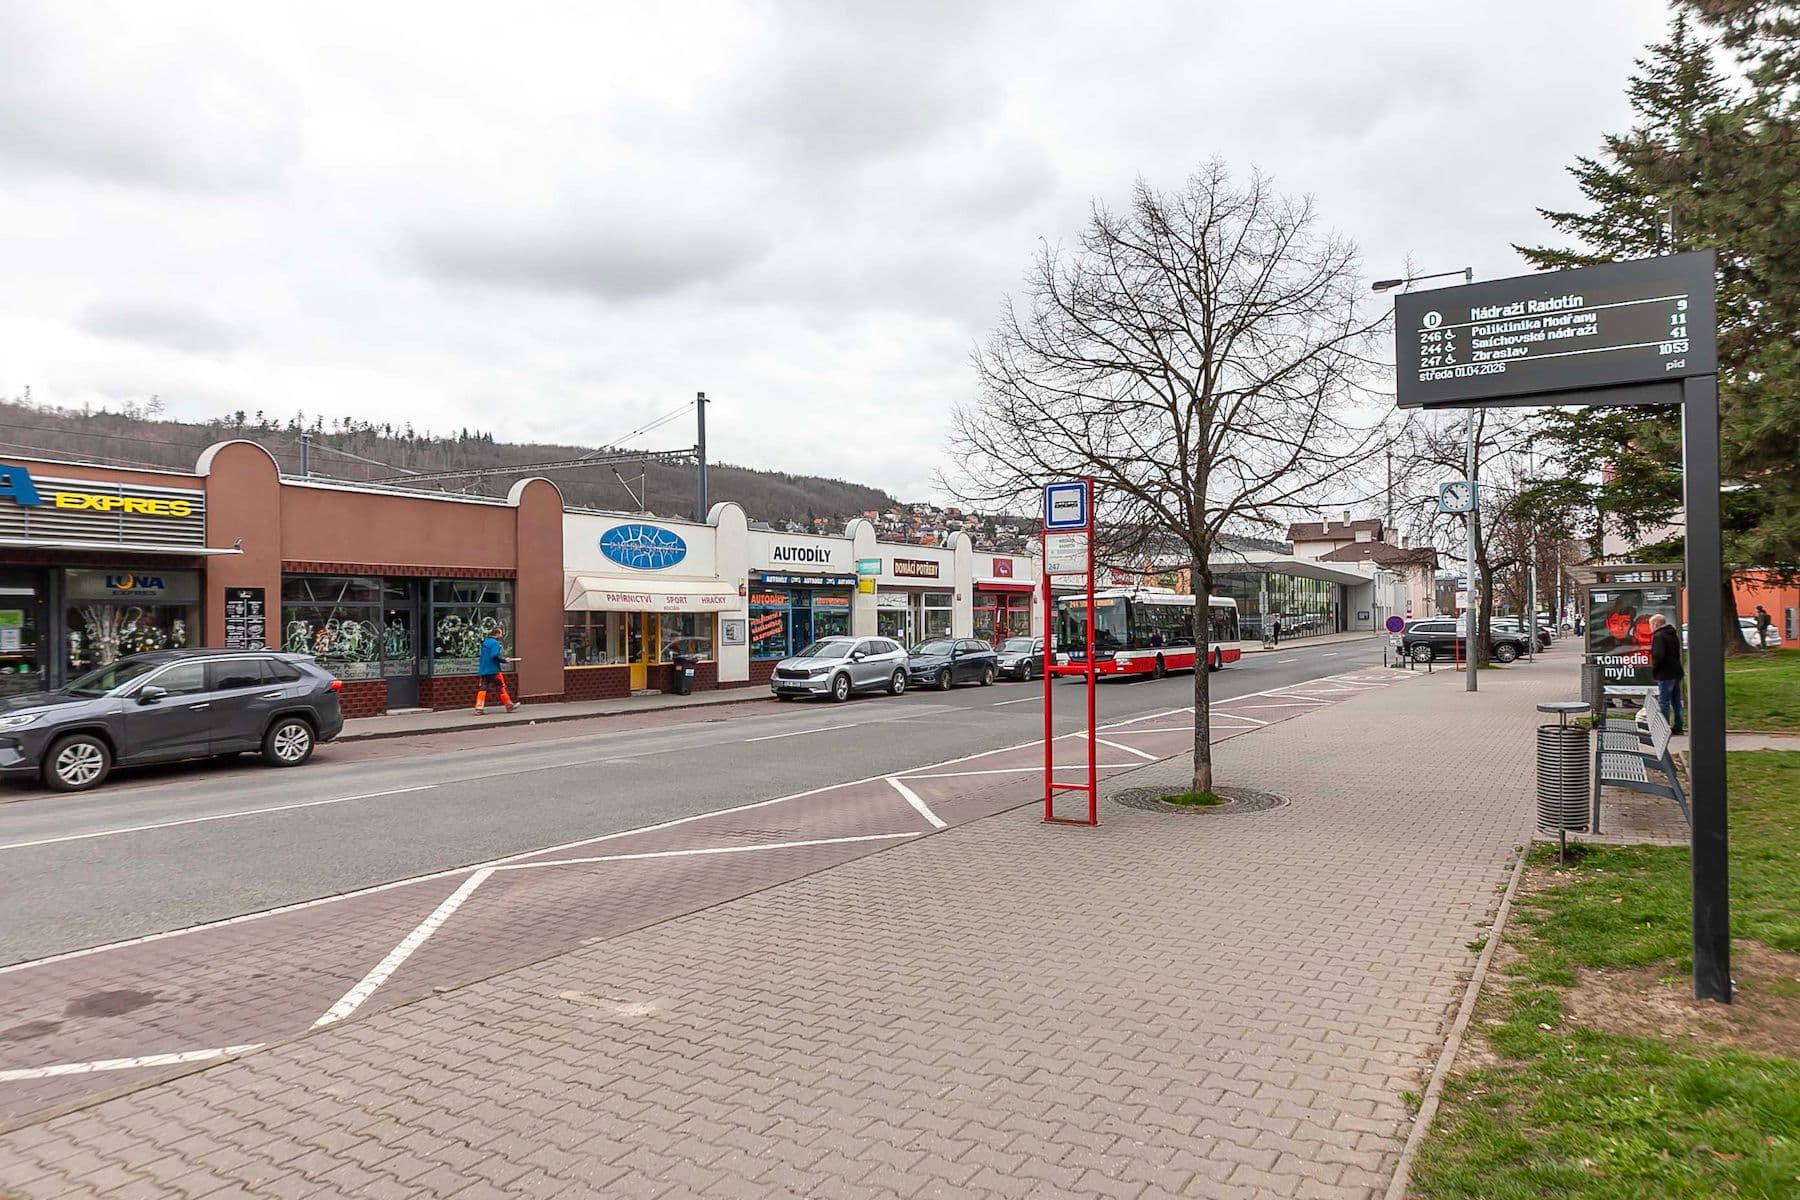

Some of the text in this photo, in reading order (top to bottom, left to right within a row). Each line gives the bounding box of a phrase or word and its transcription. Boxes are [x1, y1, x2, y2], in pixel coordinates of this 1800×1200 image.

[1471, 302, 1525, 320] Nádraží
[1528, 295, 1583, 313] Radotín
[1420, 299, 1688, 343] 246 Poliklinika Modřany 9
[1420, 313, 1687, 356] 244 Smíchovské nádraží 11
[1420, 327, 1687, 368] 247 Zbraslav 41
[1666, 359, 1685, 371] pid
[1419, 369, 1453, 381] středa
[55, 492, 192, 517] EXPRES
[773, 545, 831, 562] AUTODÍLY
[894, 561, 916, 575] DOMÁCÍ
[916, 561, 938, 577] POTŘEBY
[106, 573, 164, 589] LUNA
[606, 593, 652, 603] PAPÍRNICTVÍ
[666, 596, 687, 604] SPORT
[751, 592, 785, 604] AUTODÍLY
[1596, 653, 1649, 665] Komedie
[1604, 664, 1635, 680] mylů
